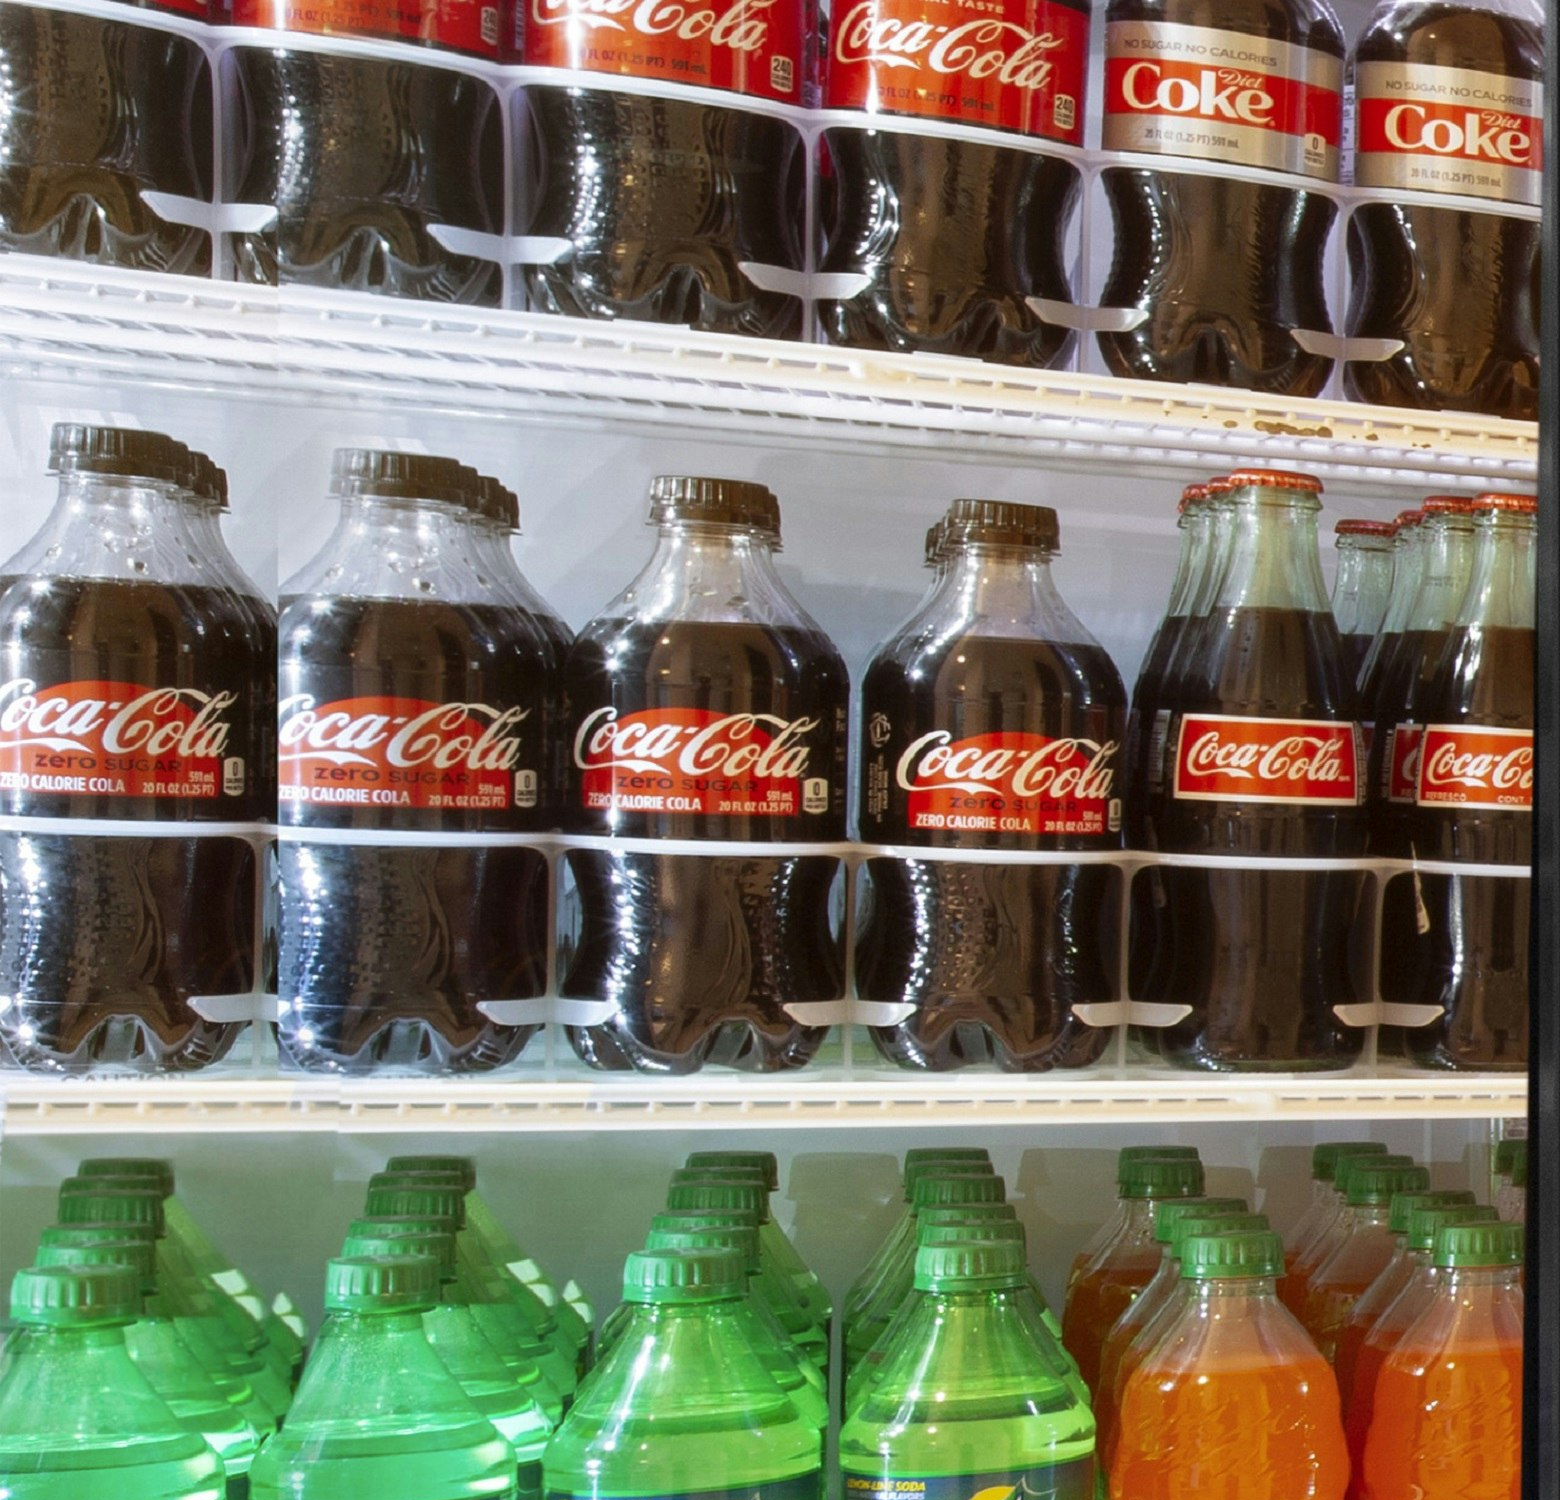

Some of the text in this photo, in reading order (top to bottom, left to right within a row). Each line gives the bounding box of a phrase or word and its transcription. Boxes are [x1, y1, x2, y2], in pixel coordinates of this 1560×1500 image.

[837, 0, 1064, 90] Coca-Cola
[1124, 39, 1278, 67] NO SUGAR NO CALORIES
[1217, 67, 1264, 91] Diet
[1122, 61, 1274, 125] Coke
[1386, 80, 1533, 109] NO SUGAR NO CALORIES
[1480, 109, 1521, 131] Diet
[1384, 104, 1531, 164] Coke
[279, 692, 532, 771] Coca-Cola
[573, 705, 822, 779] Coca-Cola
[35, 753, 183, 775] zero SUGAR
[896, 730, 1121, 800] Coca-Cola
[1186, 730, 1345, 782] Coca-Cola
[0, 774, 126, 794] ZERO CALORIE COLA
[313, 766, 470, 786] zero SUGAR
[616, 775, 758, 793] zero SUGAR
[278, 786, 411, 805] ZERO CALORIE COLA
[588, 793, 702, 811] ZERO CALORIE COLA
[949, 796, 1007, 812] zero
[915, 813, 1032, 831] ZERO CALORIE COLA
